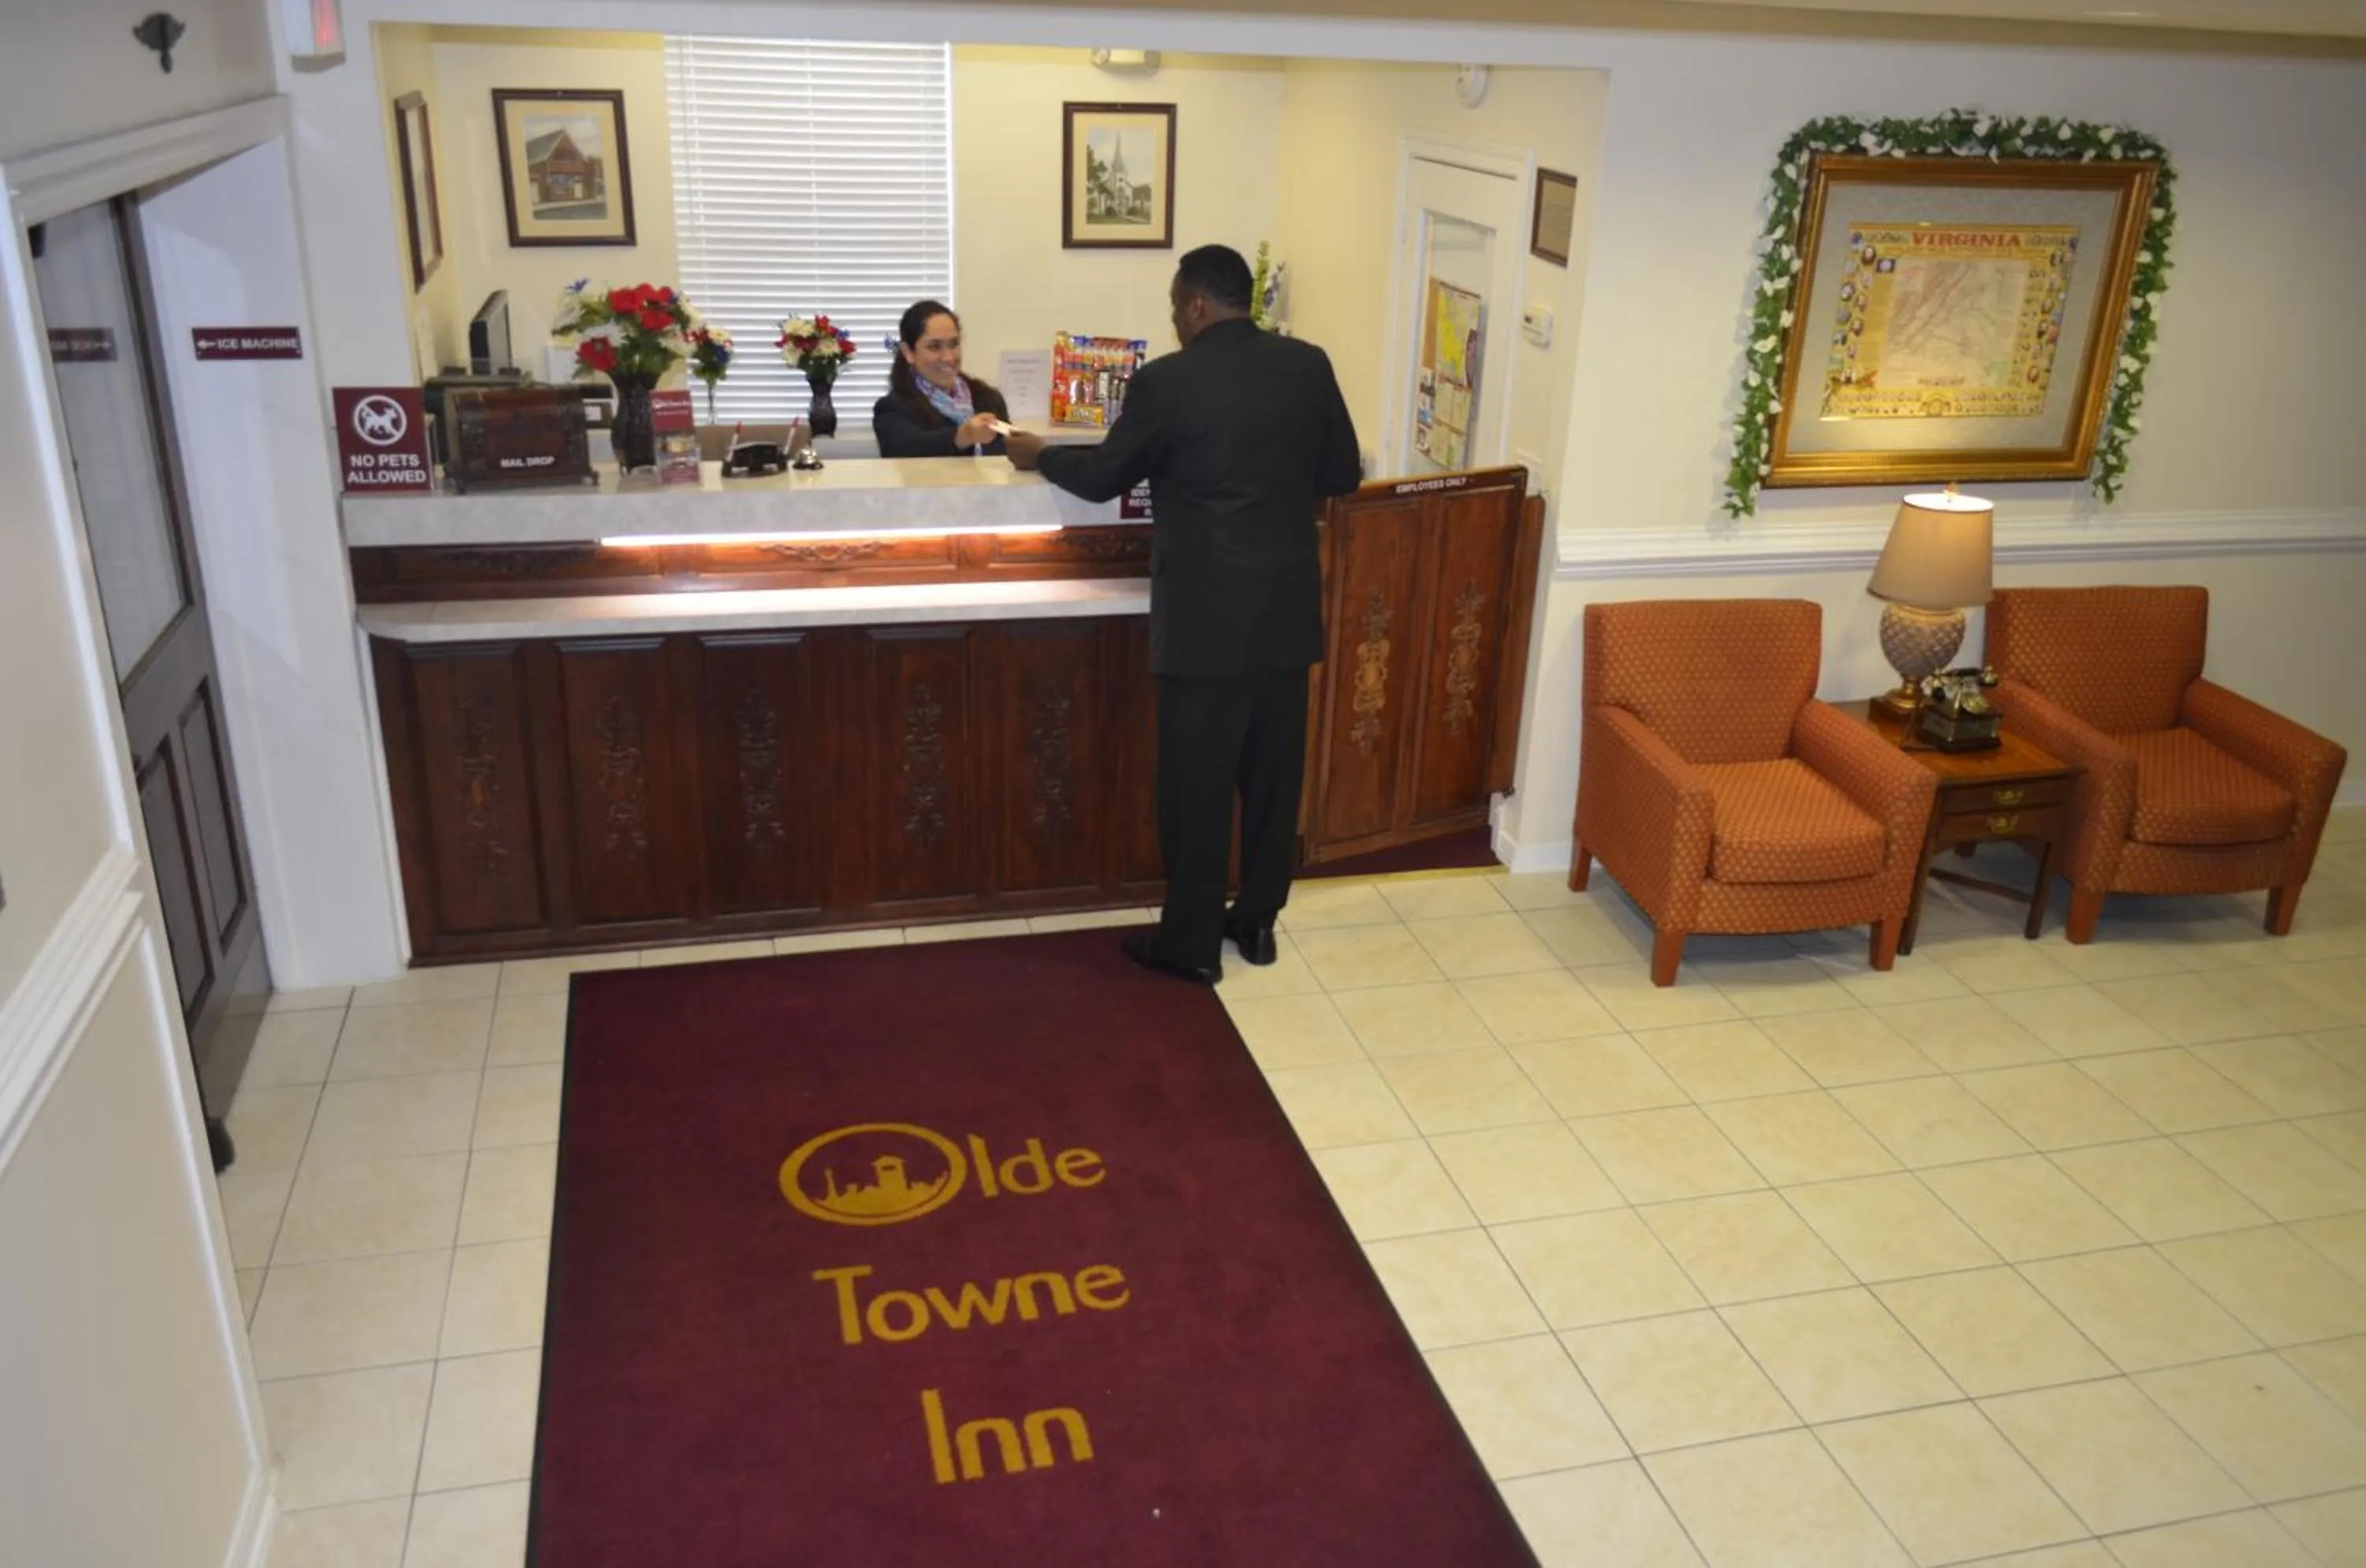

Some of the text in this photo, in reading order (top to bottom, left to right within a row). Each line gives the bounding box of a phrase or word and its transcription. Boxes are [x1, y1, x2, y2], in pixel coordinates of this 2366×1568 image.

[1912, 233, 2021, 247] VIRGINIA
[217, 338, 300, 349] ICE MACHINE
[351, 454, 420, 467] NO PETS
[501, 455, 555, 468] MAIL DROP
[348, 470, 427, 483] ALLOWED
[1395, 476, 1467, 493] EMPLOYEES ONLY
[779, 1122, 1106, 1226] Olde
[812, 1264, 1130, 1344] Towne
[921, 1388, 1094, 1484] Inn
